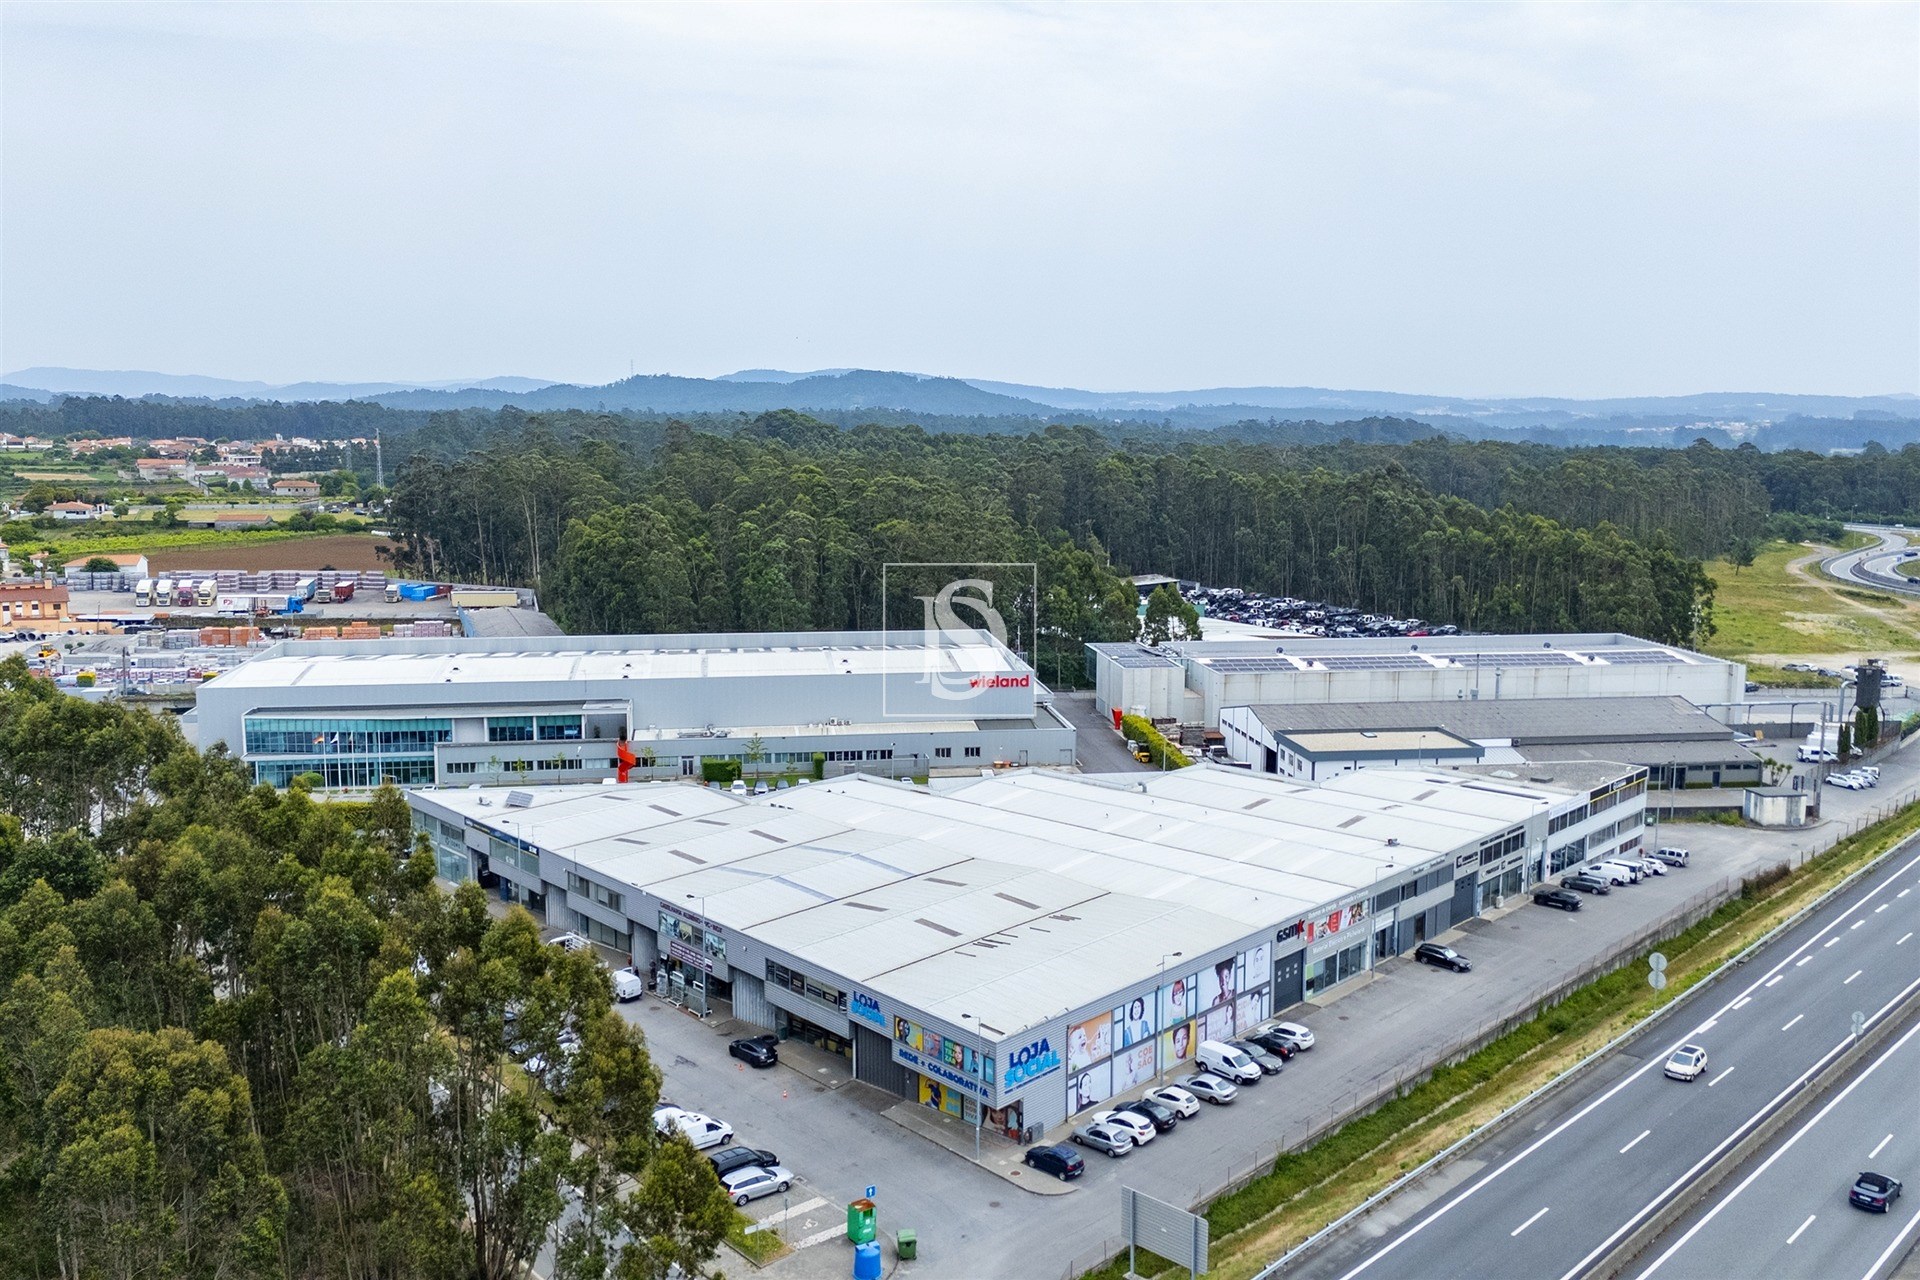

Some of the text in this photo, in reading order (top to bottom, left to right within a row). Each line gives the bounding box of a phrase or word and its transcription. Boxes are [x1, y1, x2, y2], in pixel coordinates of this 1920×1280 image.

[969, 674, 1029, 688] wieland
[853, 990, 880, 1012] LOJA
[1009, 1038, 1050, 1068] LOJA
[1138, 1045, 1153, 1058] COE
[1003, 1049, 1061, 1089] SOCIAL
